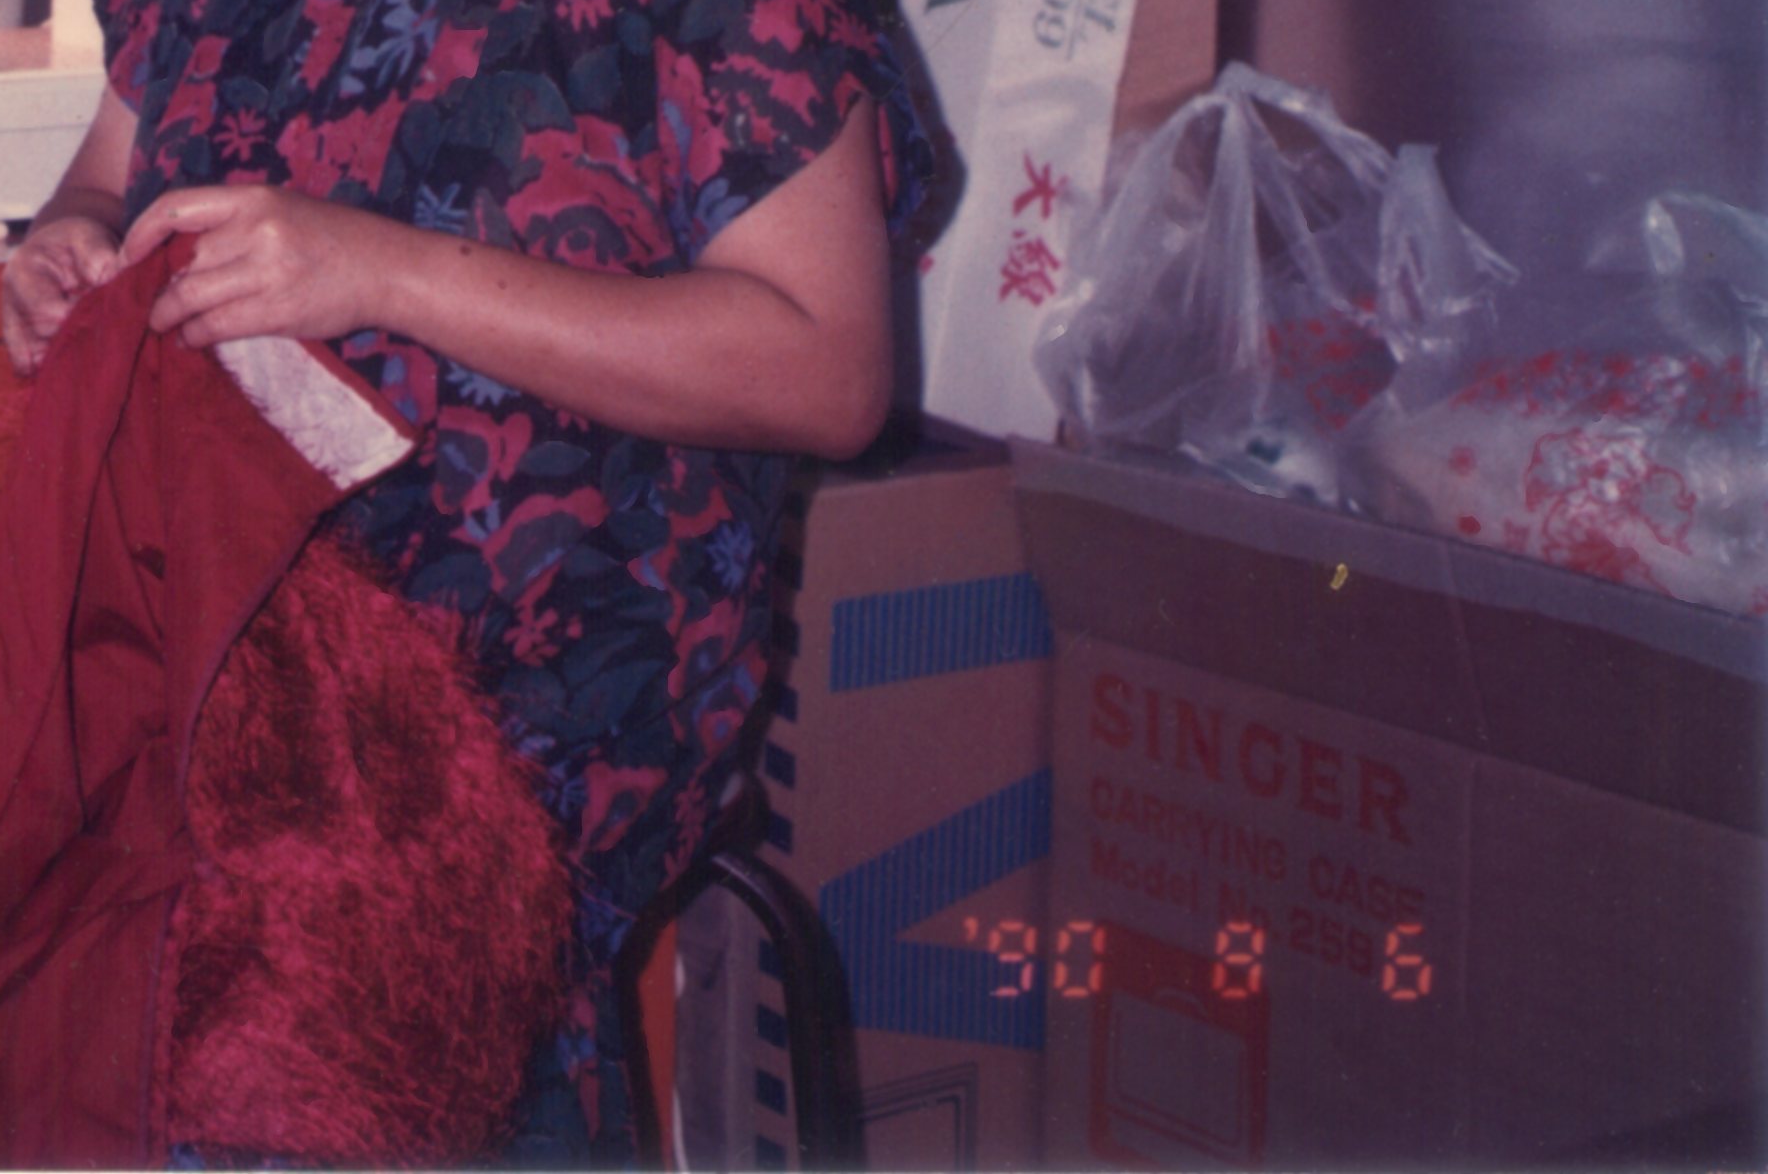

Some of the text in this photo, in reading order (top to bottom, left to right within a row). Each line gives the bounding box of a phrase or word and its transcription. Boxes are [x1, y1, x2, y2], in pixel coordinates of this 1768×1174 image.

[998, 151, 1070, 307] 天線
[1091, 672, 1412, 845] SINGER
[1090, 776, 1425, 922] CARRYING CASE
[1090, 837, 1198, 912] Model
